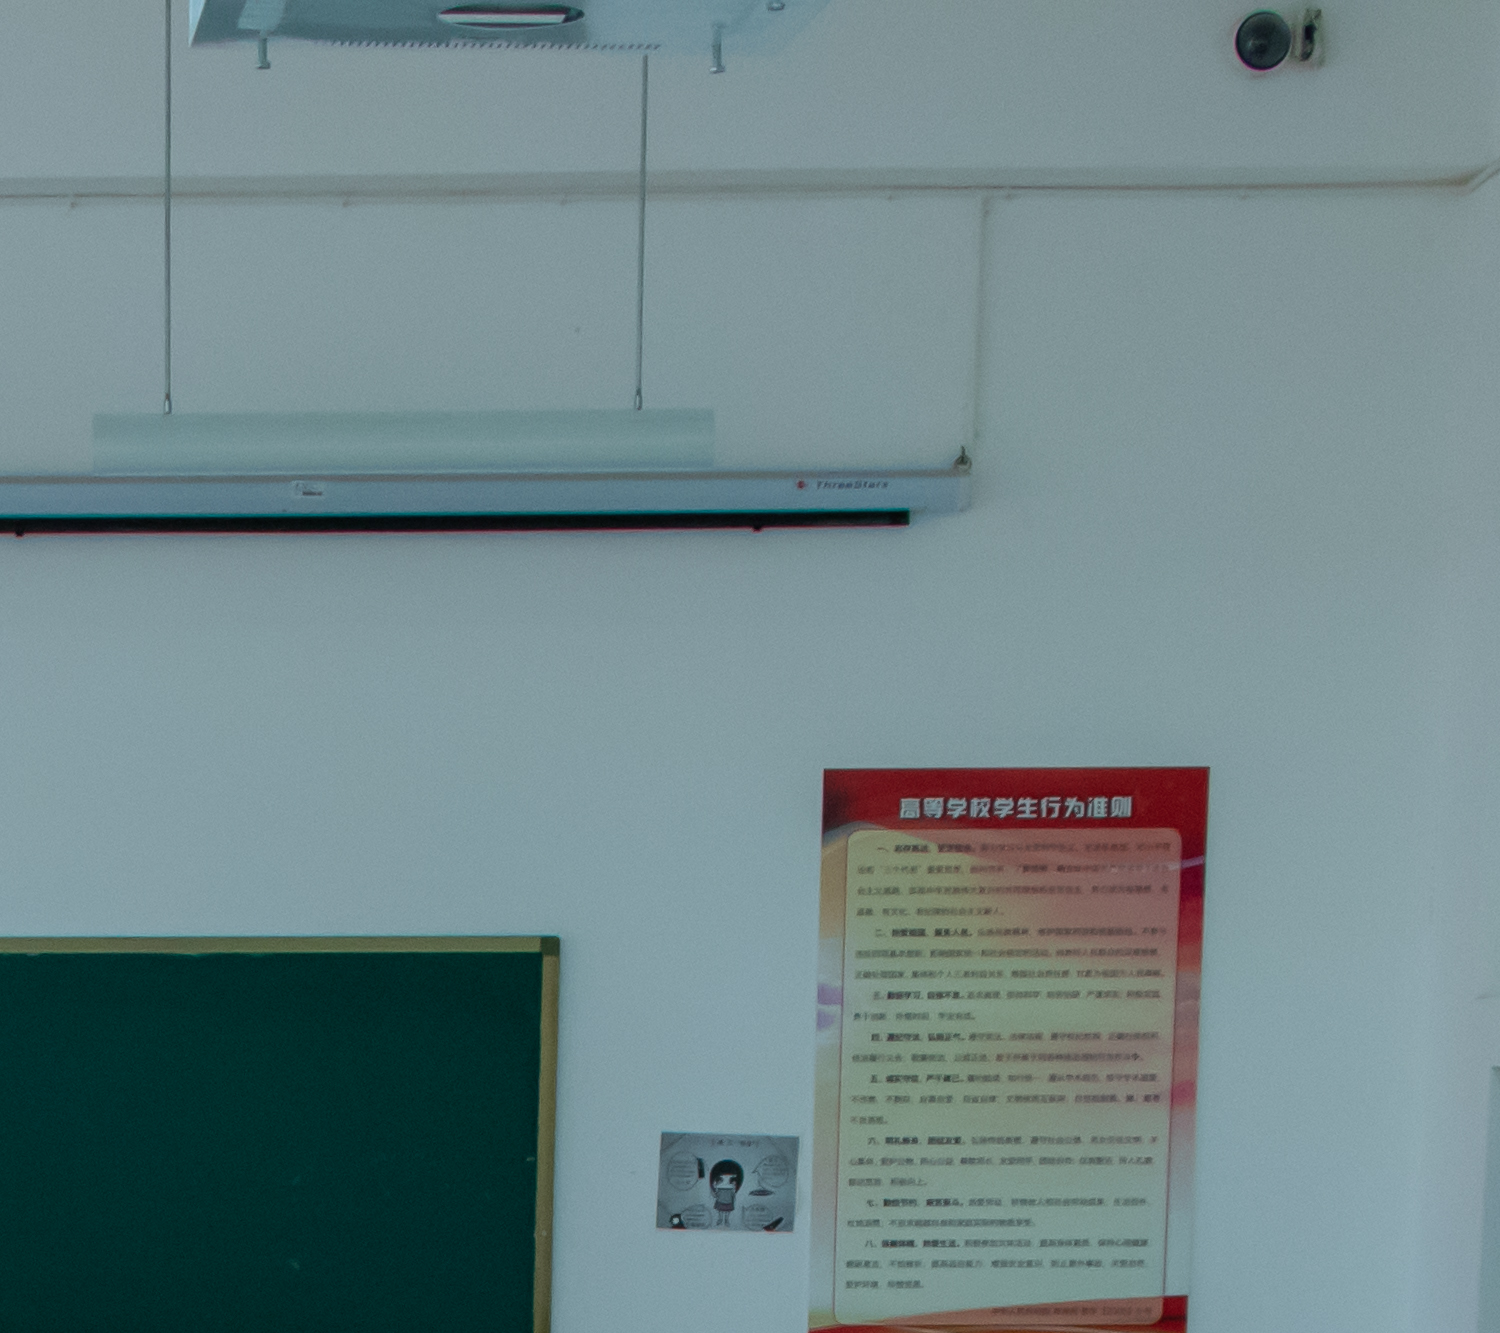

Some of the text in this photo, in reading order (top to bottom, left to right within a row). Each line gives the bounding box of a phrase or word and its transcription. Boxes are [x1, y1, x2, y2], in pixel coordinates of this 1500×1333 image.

[899, 796, 1133, 819] 高等学校学生行为准则
